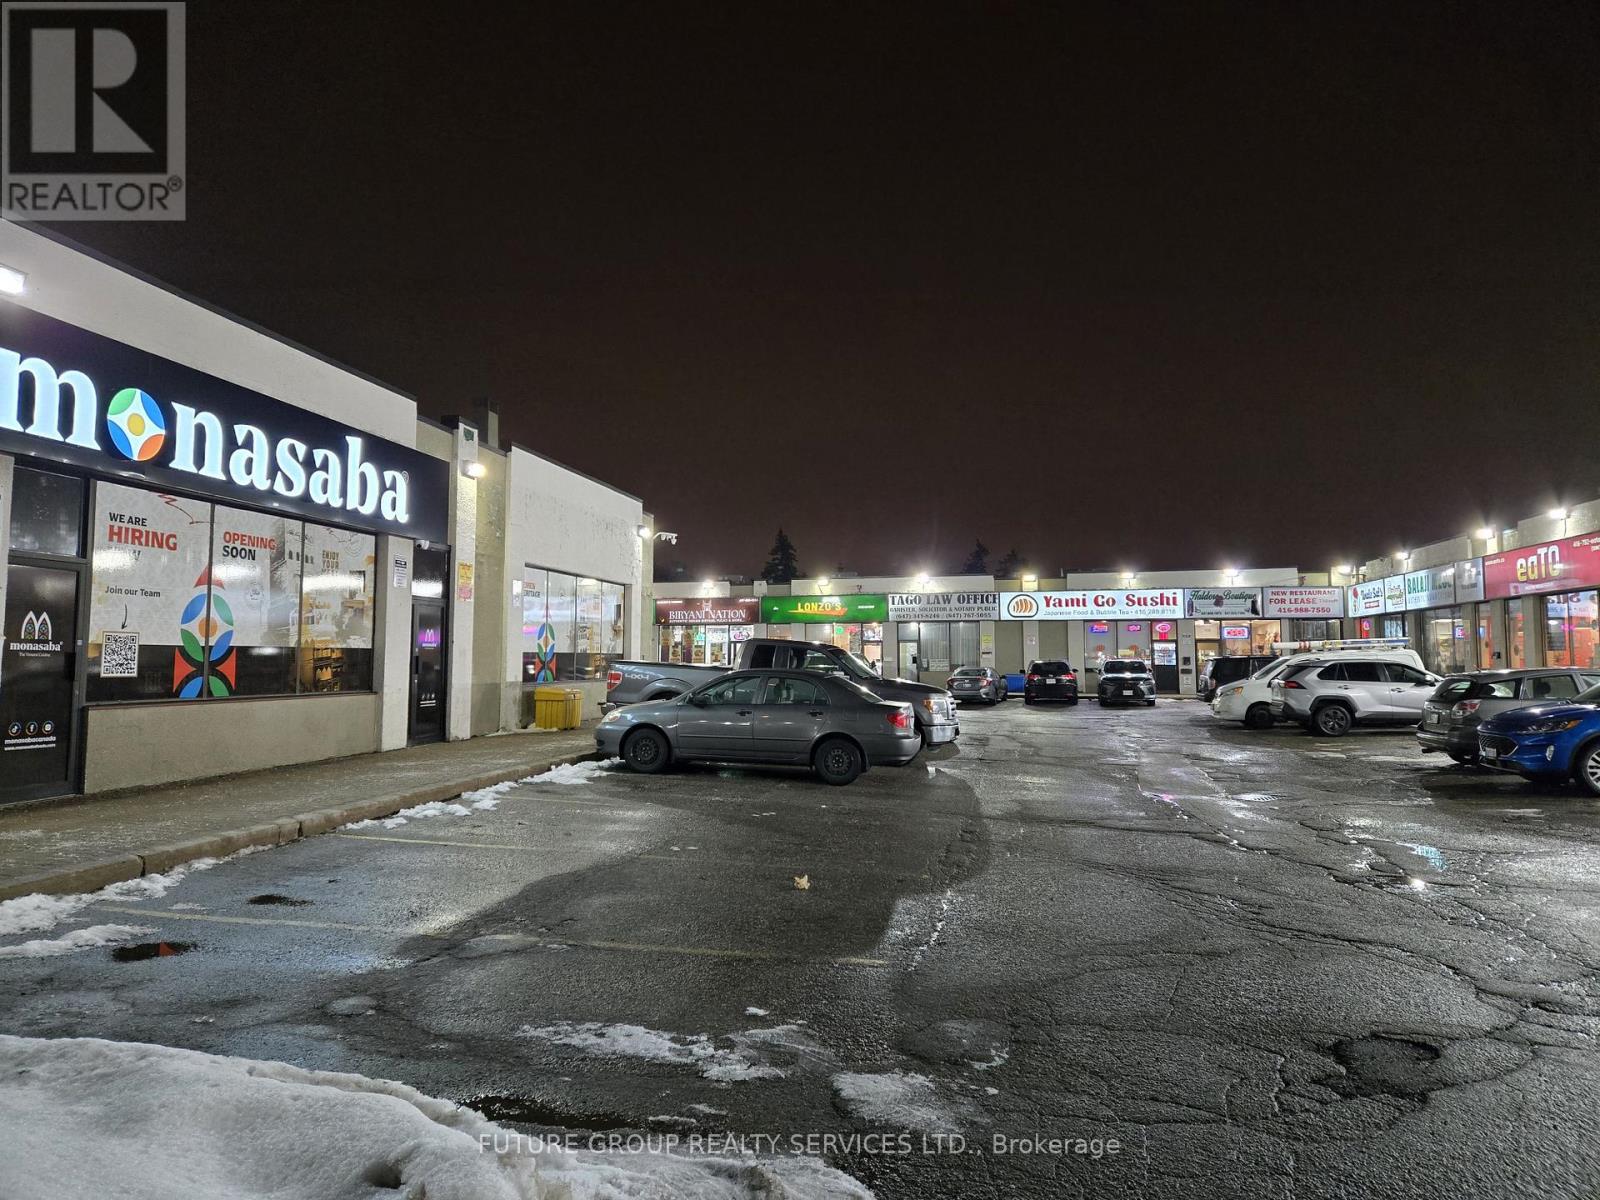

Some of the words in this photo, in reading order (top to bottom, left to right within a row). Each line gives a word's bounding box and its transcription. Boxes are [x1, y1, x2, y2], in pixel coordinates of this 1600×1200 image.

[109, 512, 125, 523] WE
[127, 515, 147, 527] ARE
[108, 525, 178, 551] HIRING
[223, 531, 277, 551] OPENING
[222, 545, 256, 560] SOON
[322, 550, 339, 560] ENJOY
[322, 560, 339, 569] YOUR
[1516, 545, 1560, 582] eaTO
[105, 585, 122, 595] Join
[140, 588, 161, 597] Team
[890, 595, 921, 606] TAGO
[926, 594, 953, 605] LAW
[1043, 593, 1087, 607] Yami
[1094, 594, 1116, 607] Go
[1126, 592, 1178, 607] Sushi
[1289, 597, 1317, 605] LEASE
[797, 602, 842, 611] LONZO'S
[669, 610, 705, 620] BIRYANI
[708, 609, 746, 619] NATION
